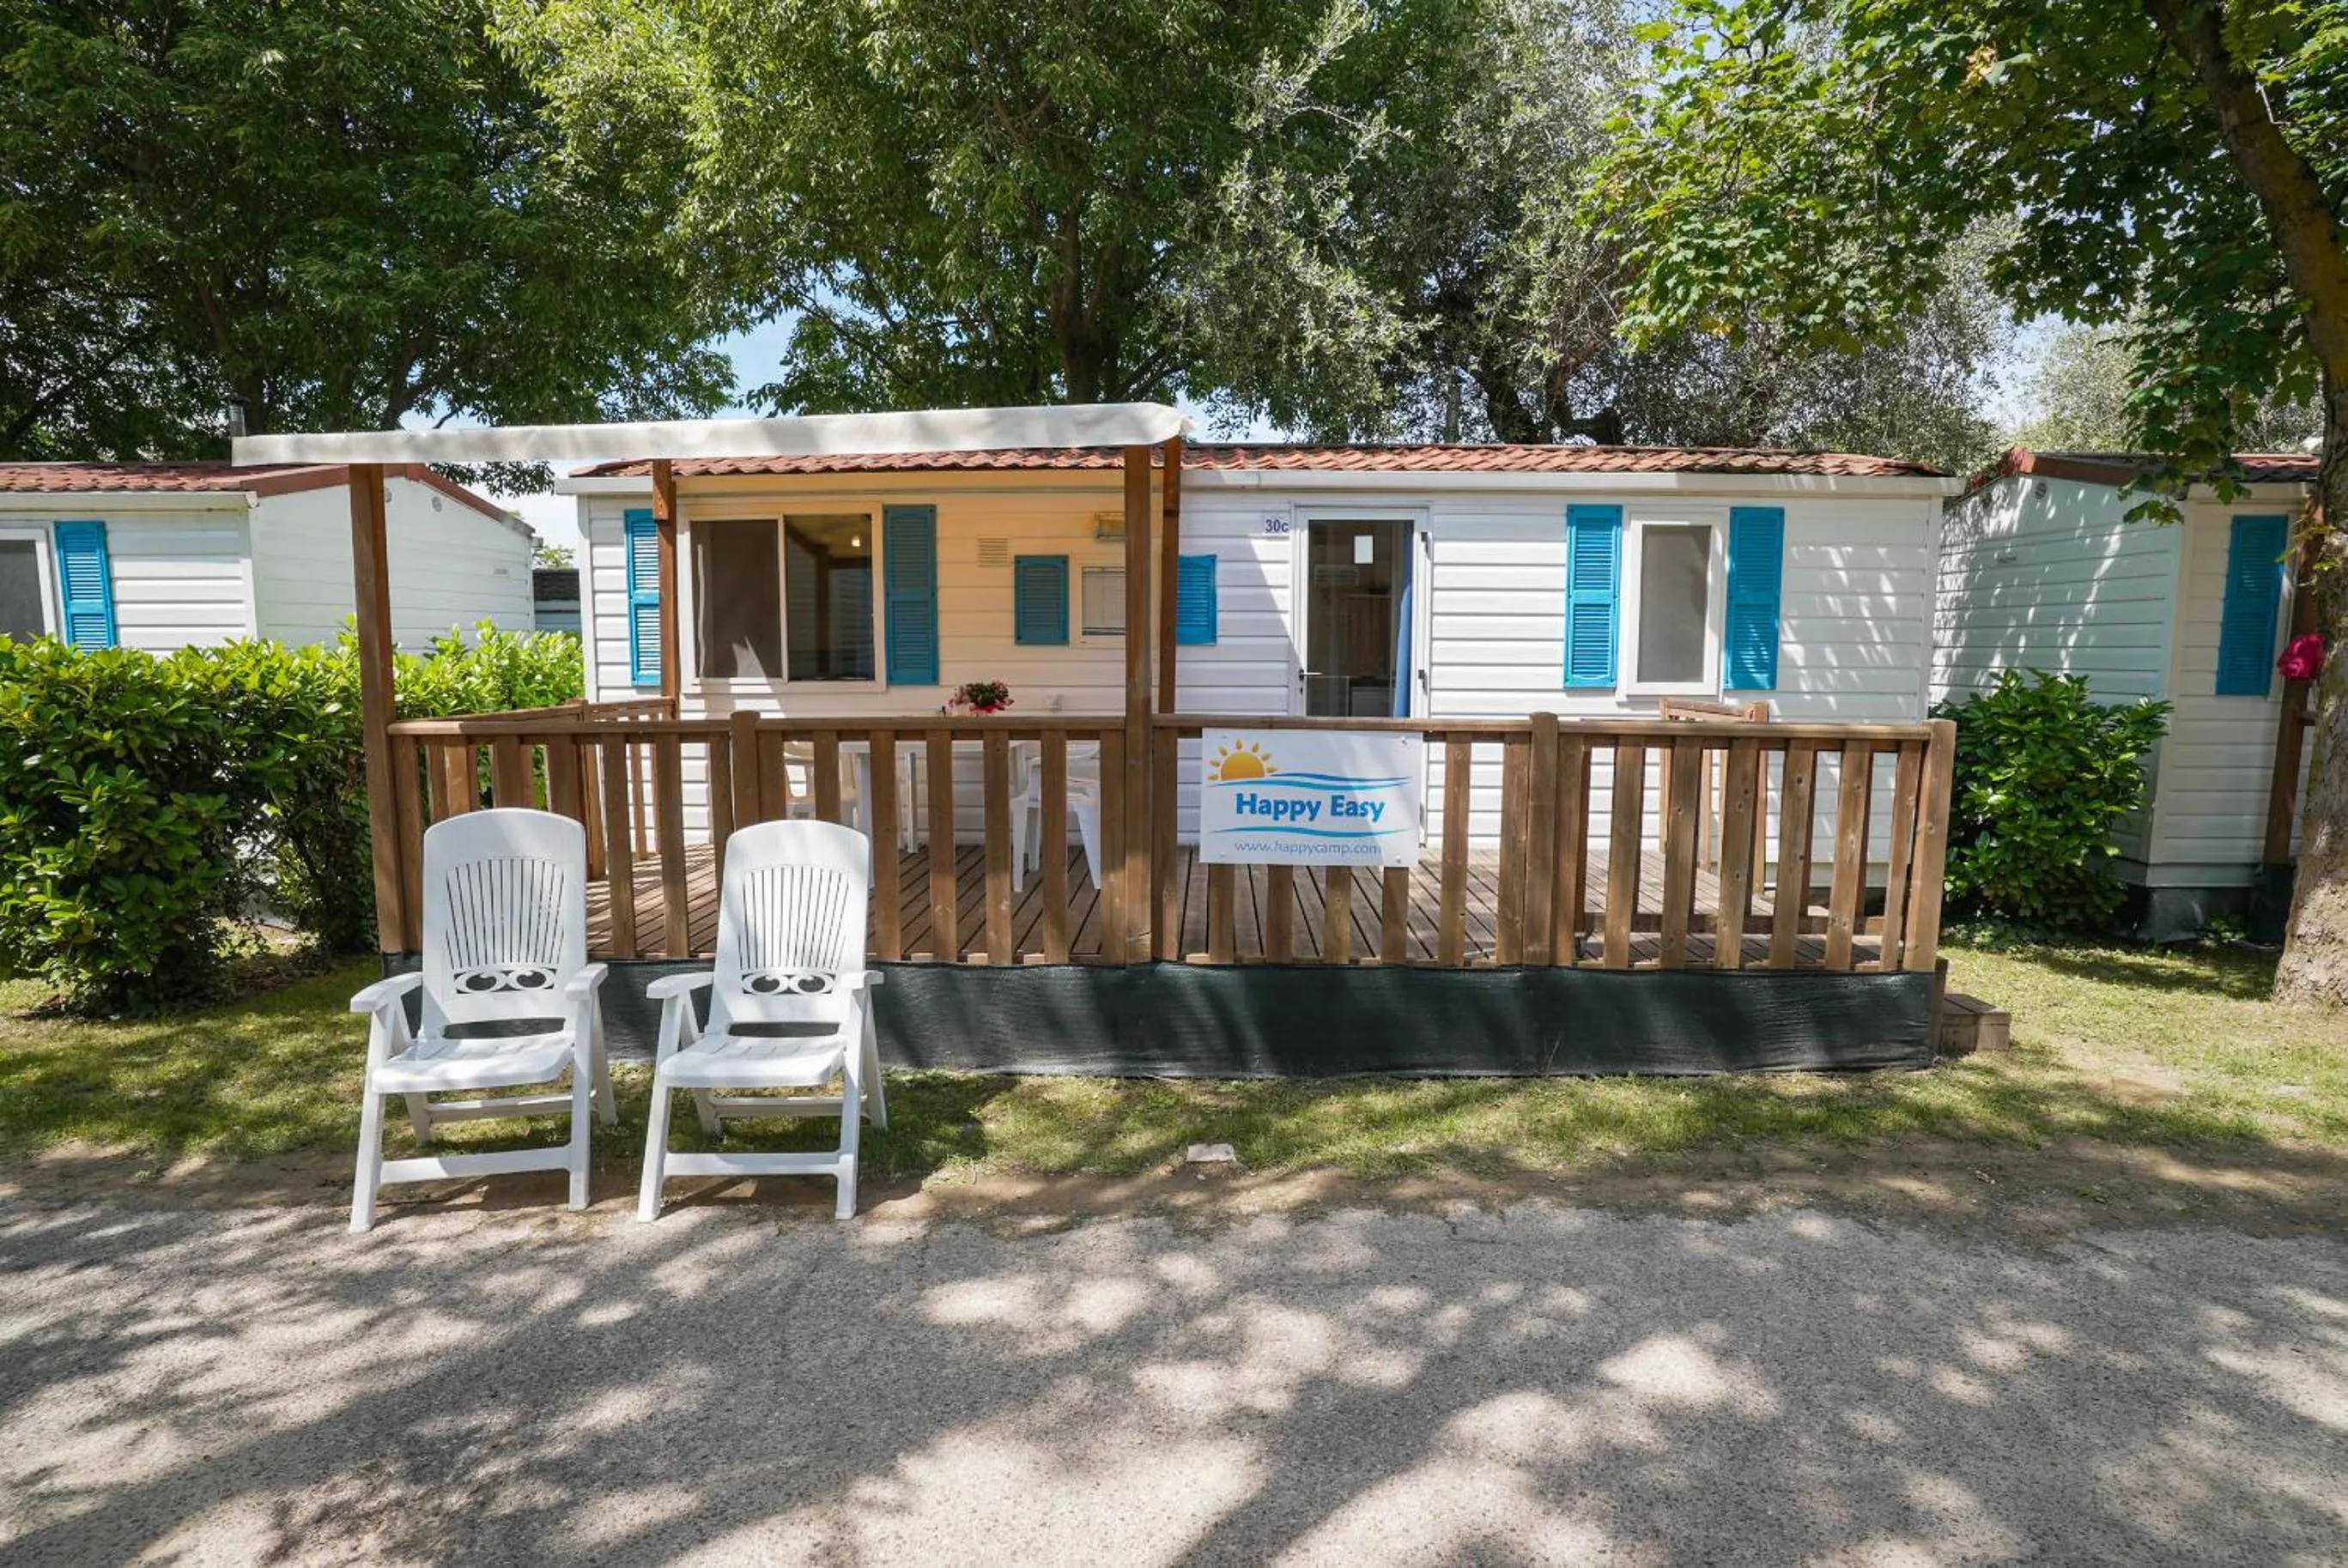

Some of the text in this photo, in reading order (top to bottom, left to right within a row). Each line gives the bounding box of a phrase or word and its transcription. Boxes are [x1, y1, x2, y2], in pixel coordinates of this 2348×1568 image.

[1265, 518, 1289, 533] 30c
[1235, 792, 1386, 822] Happy Easy
[1235, 840, 1382, 857] www.happycamp.com
